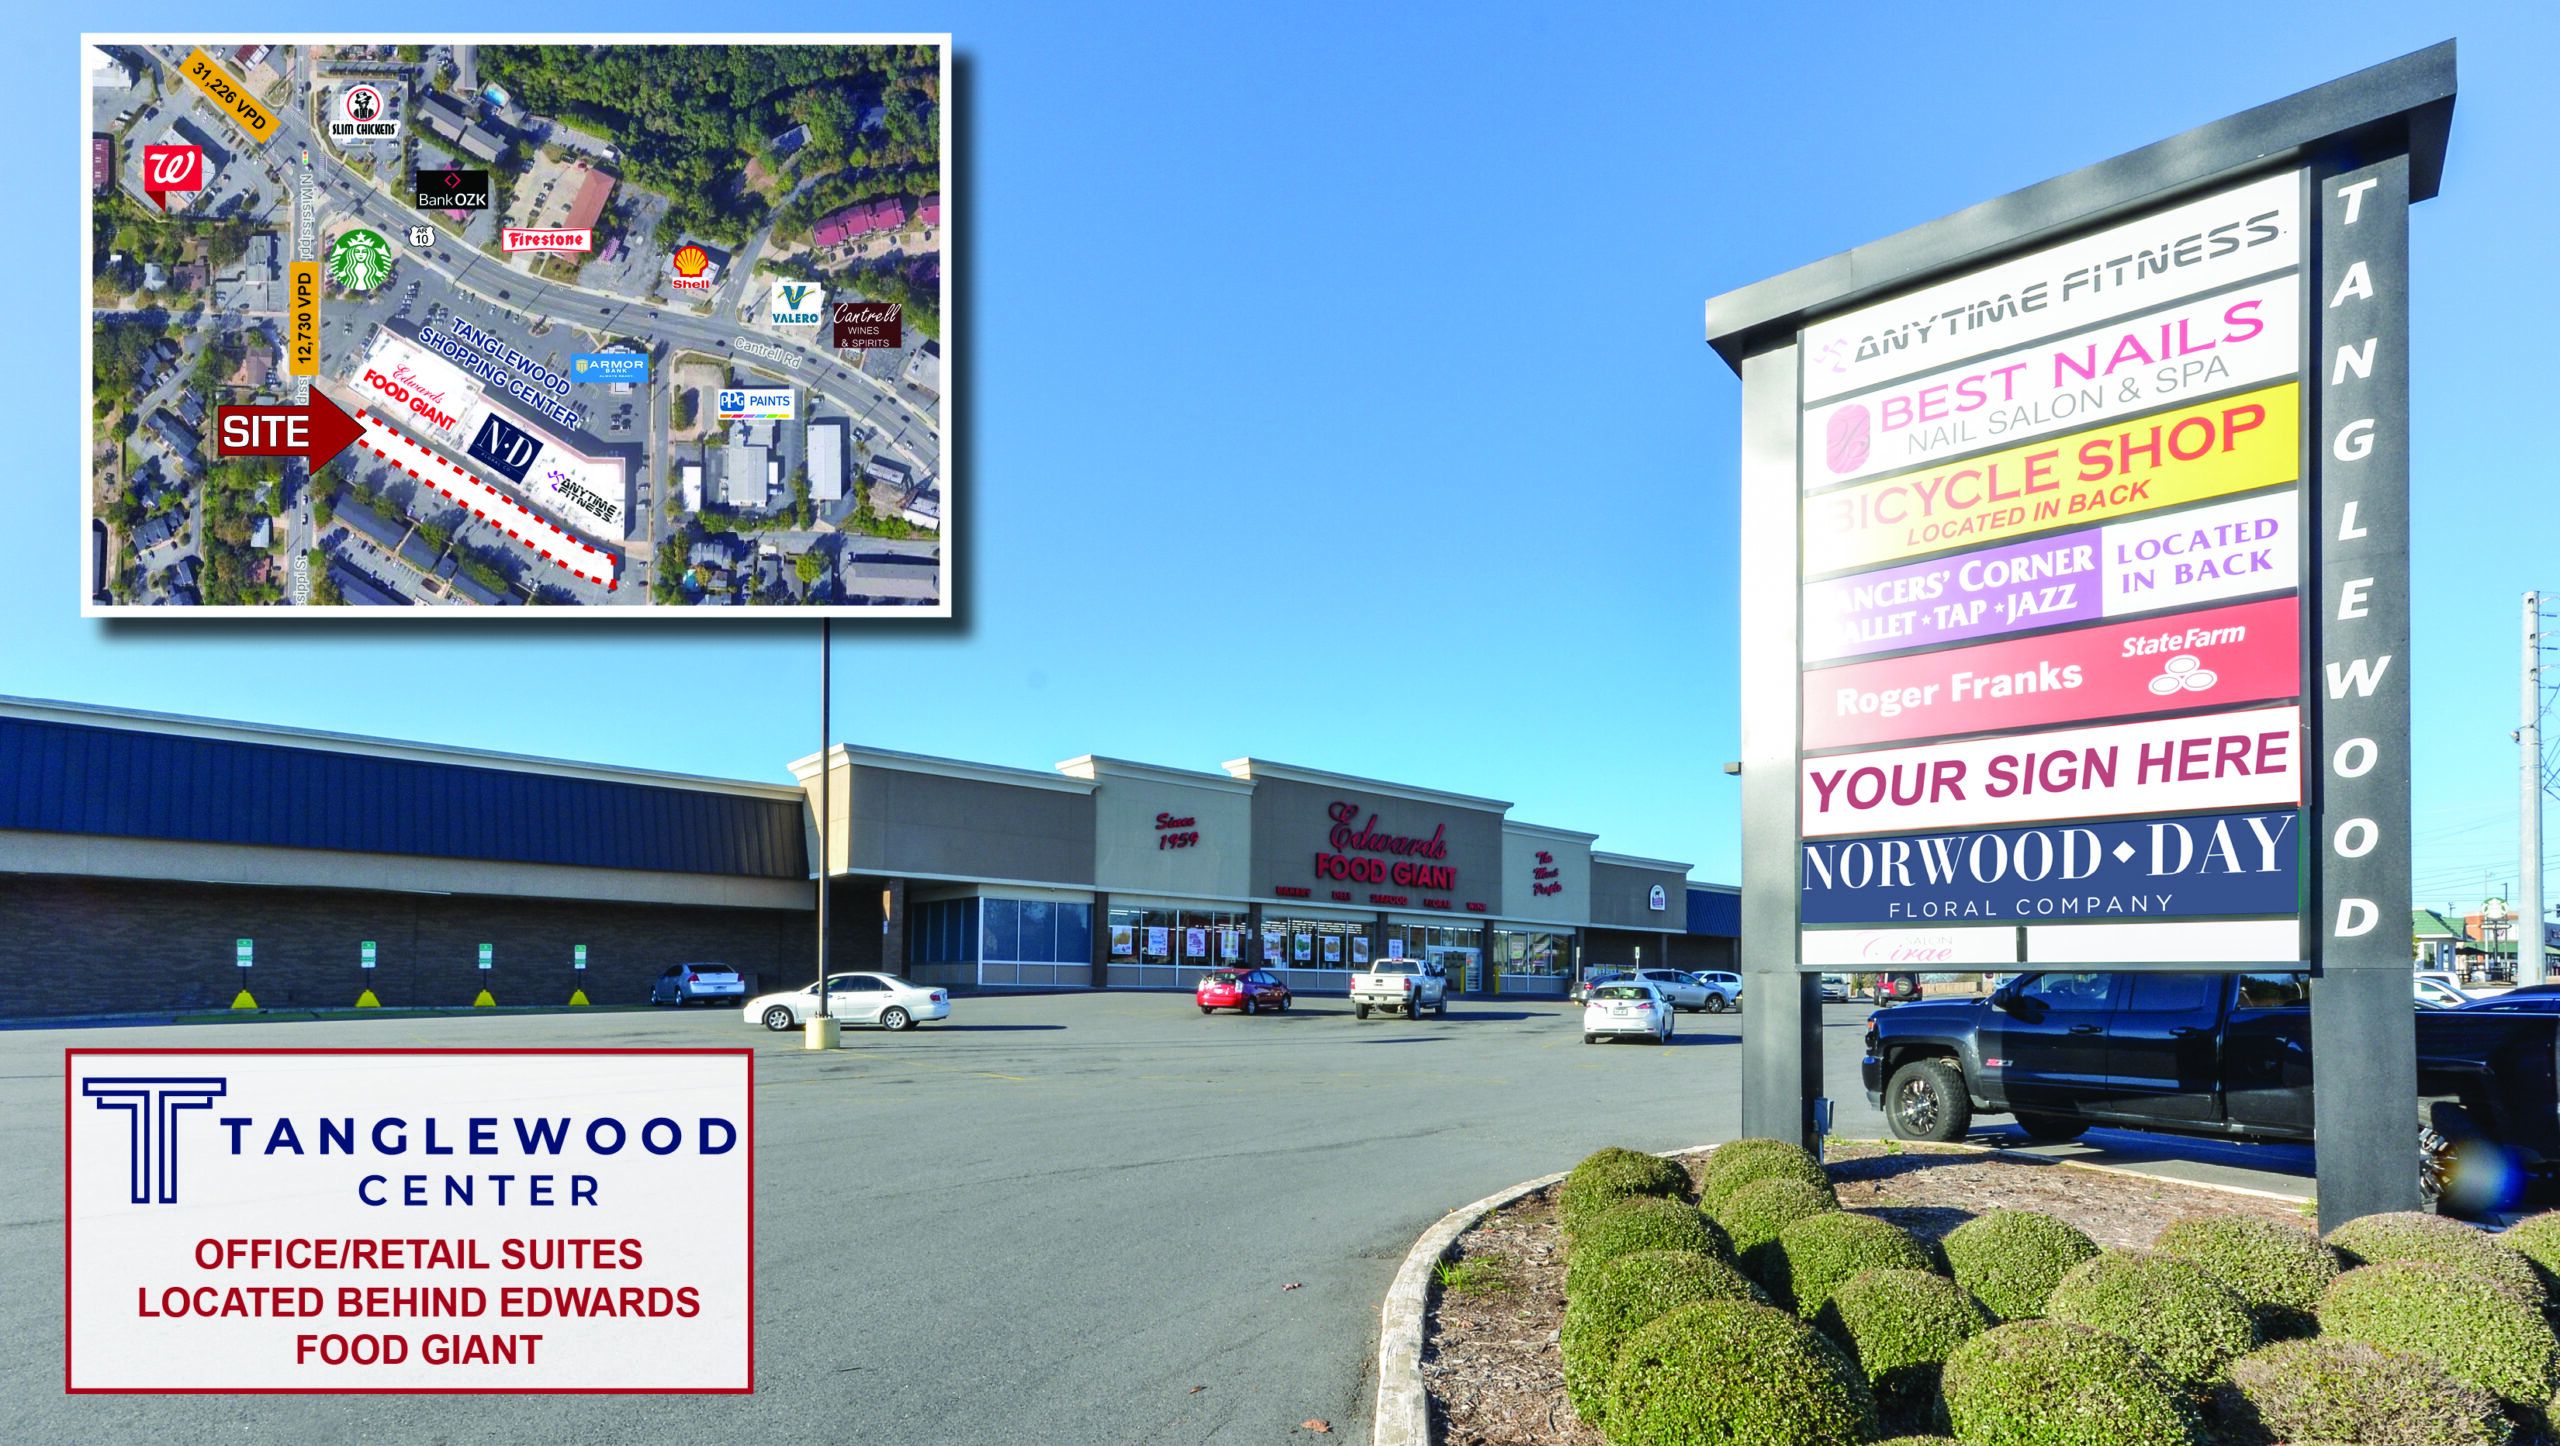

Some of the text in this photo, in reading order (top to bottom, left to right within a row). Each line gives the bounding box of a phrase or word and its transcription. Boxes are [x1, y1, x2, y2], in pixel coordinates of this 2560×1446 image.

[1854, 281, 2048, 363] ANYTIME
[1881, 300, 2264, 432] BEST NAILS
[1908, 356, 2229, 455] NAIL SALON & SPA
[2079, 404, 2266, 482] SHOP
[1907, 482, 2150, 546] LOCATED IN BACK
[2117, 518, 2279, 565] LOCATED
[1958, 544, 2096, 592] CORNER
[2122, 548, 2273, 594] IN BACK
[2326, 178, 2391, 940] TANGLEWOOD
[1934, 600, 1987, 630] TAP
[2007, 583, 2078, 625] JAZZ
[1836, 661, 2083, 717] Roger Franks
[1809, 730, 2290, 813] YOUR SIGN HERE
[1160, 831, 1199, 850] 1959
[1328, 801, 1448, 860] Edwards
[1802, 814, 2297, 891] NORWOOD DAY
[1276, 886, 1311, 897] BAKERY
[1332, 891, 1351, 901] DELI
[1370, 894, 1409, 905] SEAFOOD
[1467, 902, 1487, 911] WINE
[1315, 852, 1457, 890] FOOD GIANT
[1889, 894, 2174, 919] FLORAL COMPANY
